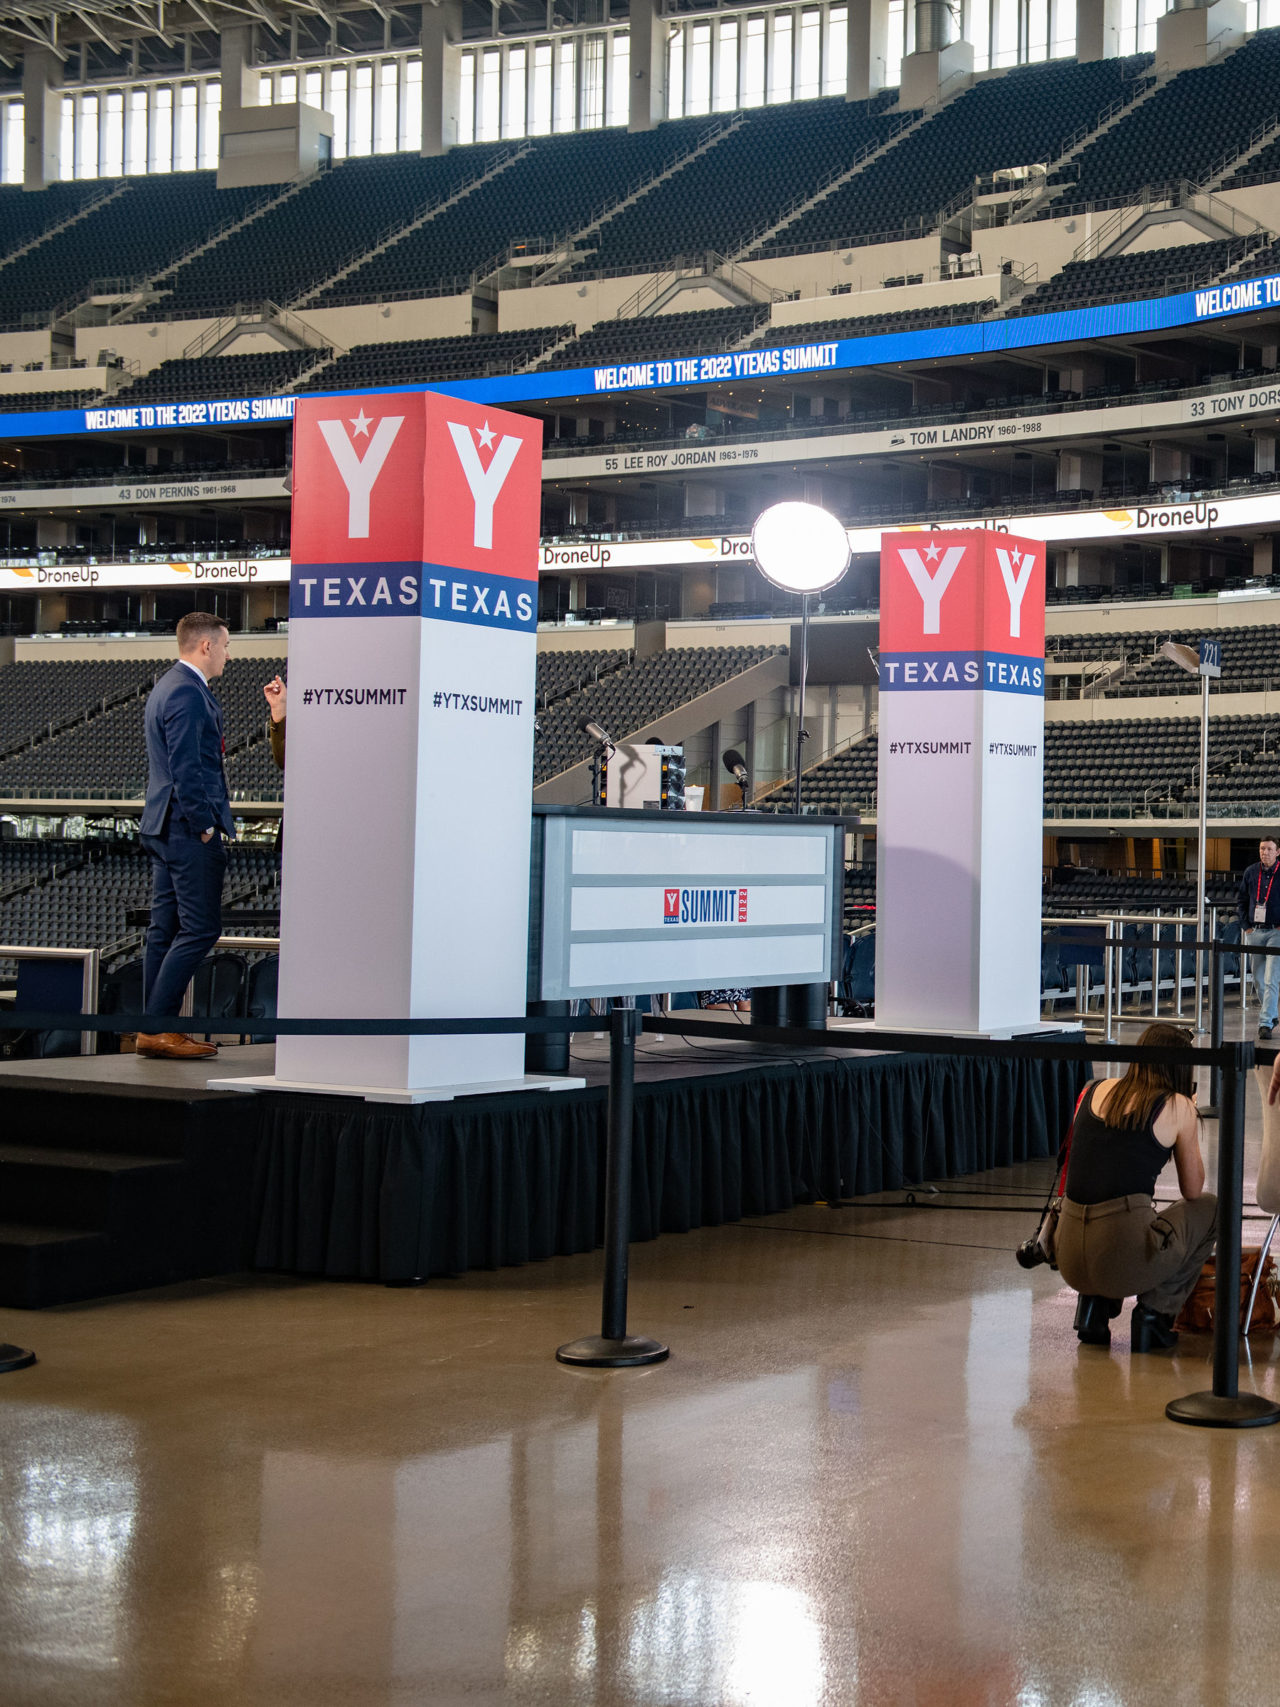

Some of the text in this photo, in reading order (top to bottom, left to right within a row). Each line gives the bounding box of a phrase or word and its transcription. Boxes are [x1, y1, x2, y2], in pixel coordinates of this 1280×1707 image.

[1195, 281, 1262, 317] WELCOME
[595, 344, 838, 390] WELCOME TO THE 2022 YTEXAS SUMMIT
[85, 408, 139, 430] WELCOME
[140, 406, 154, 427] TO
[156, 405, 177, 426] THE
[178, 403, 207, 424] 2022
[208, 400, 249, 422] YTEXAS
[1191, 402, 1205, 417] 33
[1211, 395, 1245, 414] TONY
[910, 422, 1042, 445] TOM LANDRY 1960-1988
[605, 449, 758, 470] 55 LEE ROY JORDAN 1963-1976
[318, 416, 405, 539] Y
[446, 421, 524, 549] Y
[118, 484, 237, 501] 43 DON PERKINS 1961-1968
[1136, 503, 1219, 531] DroneUp
[543, 544, 611, 568] DroneUp
[37, 565, 100, 587] DroneUp
[195, 560, 258, 582] DroneUp
[299, 575, 418, 608] TEXAS
[430, 577, 532, 621] TEXAS
[897, 546, 966, 635] Y
[996, 547, 1036, 638] Y
[1204, 642, 1218, 667] 221
[885, 660, 979, 684] TEXAS
[987, 661, 1042, 688] TEXAS
[303, 688, 407, 706] #YTXSUMMIT
[433, 691, 523, 716] #YTXSUMMIT
[889, 741, 972, 755] #YTXSUMMIT
[989, 742, 1037, 757] #YTXSUMMIT
[681, 889, 737, 923] SUMMIT
[739, 891, 747, 920] 2022
